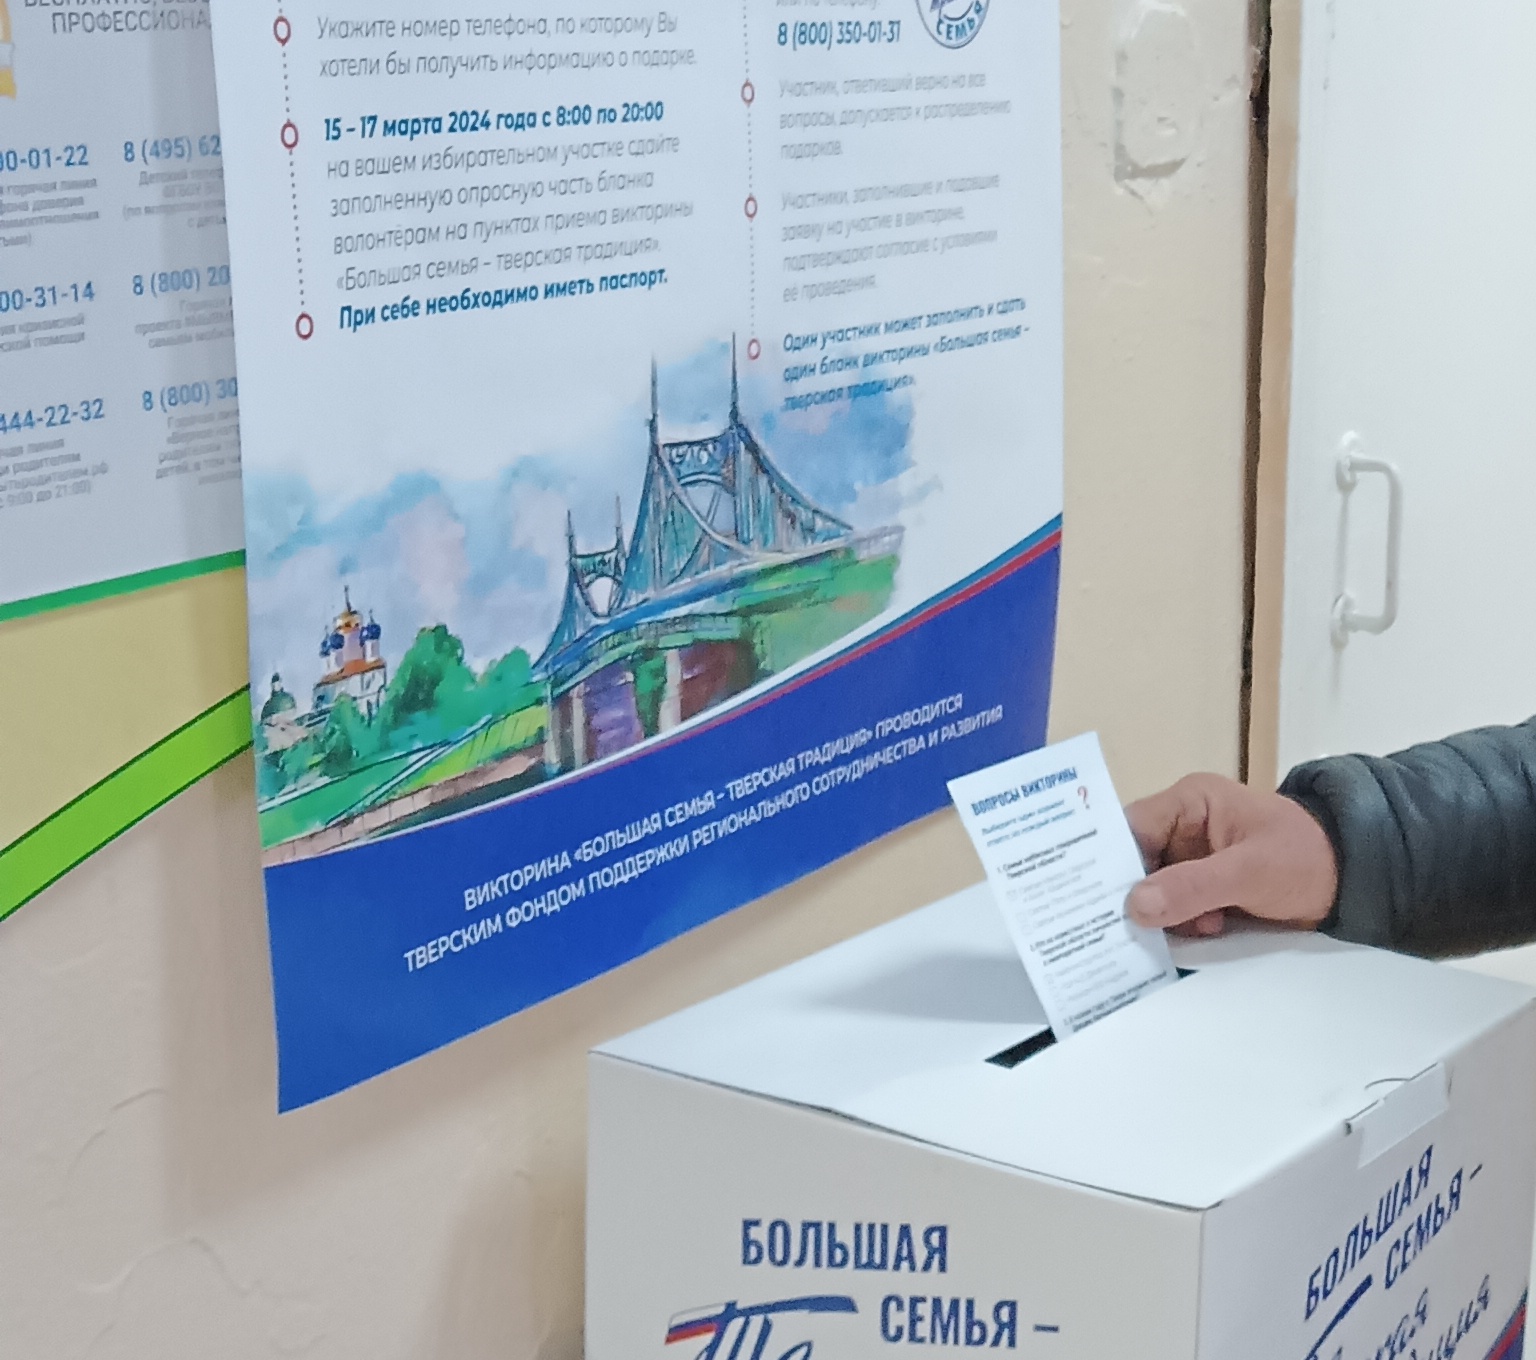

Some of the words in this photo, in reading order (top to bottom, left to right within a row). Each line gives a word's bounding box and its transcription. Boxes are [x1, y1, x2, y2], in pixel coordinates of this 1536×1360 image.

[317, 16, 396, 39] Укажите
[401, 18, 461, 38] номер
[464, 14, 551, 37] телефона,
[657, 10, 678, 33] Вы
[777, 21, 788, 46] 8
[792, 20, 833, 51] (800)
[836, 19, 902, 44] 350-01-31
[319, 56, 380, 77] хотели
[385, 50, 411, 76] бы
[416, 53, 499, 77] получить
[502, 50, 615, 72] информацию
[324, 116, 342, 141] 15
[359, 113, 379, 139] 17
[382, 115, 443, 140] марта
[447, 108, 492, 133] 2024
[495, 110, 537, 132] года
[541, 109, 552, 128] с
[555, 103, 593, 127] 8:00
[596, 106, 618, 125] по
[620, 99, 664, 123] 20:00
[124, 141, 135, 162] 8
[141, 135, 193, 165] (495)
[354, 154, 417, 177] вашем
[421, 145, 559, 171] избирательном
[560, 140, 625, 167] участке
[330, 188, 453, 217] заполненную
[457, 180, 545, 206] опросную
[548, 176, 593, 196] часть
[333, 225, 441, 255] волонтёрам
[473, 215, 540, 243] пунктах
[132, 274, 144, 296] 8
[150, 268, 200, 298] (800)
[336, 262, 422, 291] «Большая
[425, 255, 479, 279] семья
[496, 245, 573, 270] тверская
[339, 304, 376, 333] При
[380, 294, 421, 322] себе
[425, 284, 539, 315] необходимо
[543, 277, 595, 299] иметь
[598, 267, 668, 291] паспорт.
[142, 390, 154, 412] 8
[160, 380, 211, 413] (800)
[464, 850, 571, 911] ВИКТОРИНА
[574, 816, 662, 863] «БОЛЬШАЯ
[664, 790, 716, 828] СЕМЬЯ
[725, 758, 795, 802] ТВЕРСКАЯ
[797, 729, 873, 772] ТРАДИЦИЯ»
[874, 692, 963, 739] ПРОВОДИТСЯ
[403, 913, 503, 972] ТВЕРСКИМ
[505, 878, 585, 928] ФОНДОМ
[588, 833, 689, 894] ПОДДЕРЖКИ
[692, 782, 809, 848] РЕГИОНАЛЬНОГО
[811, 733, 926, 795] СОТРУДНИЧЕСТВА
[928, 728, 939, 748] И
[941, 704, 1004, 743] РАЗВИТИЯ
[741, 1217, 948, 1274] БОЛЬШАЯ
[1304, 1143, 1434, 1322] БОЛЬШАЯ
[1384, 1165, 1463, 1291] СЕМЬЯ
[880, 1294, 1018, 1349] СЕМЬЯ
